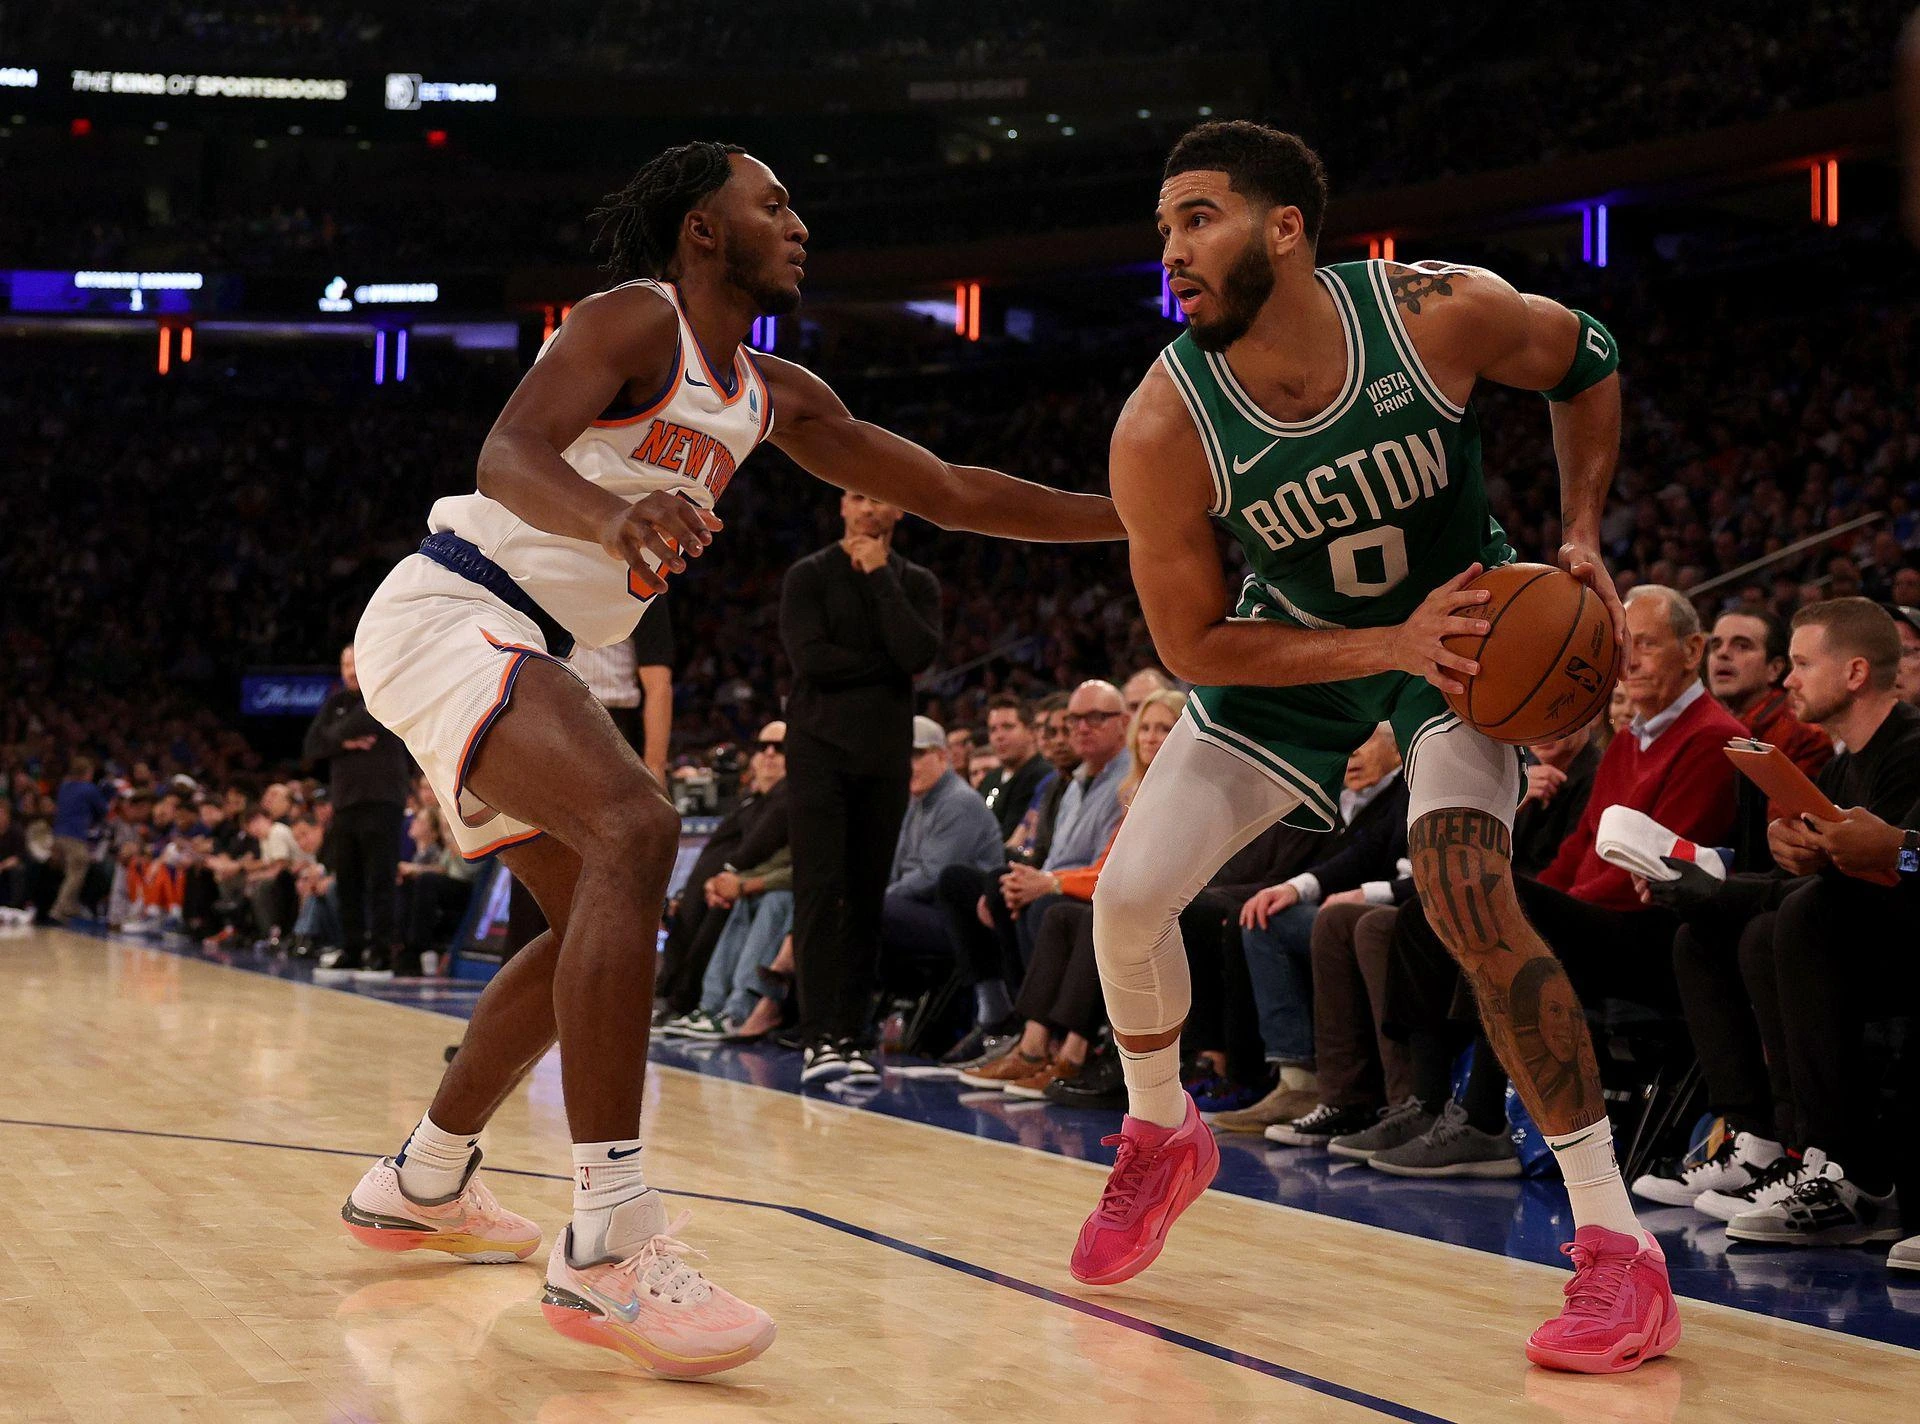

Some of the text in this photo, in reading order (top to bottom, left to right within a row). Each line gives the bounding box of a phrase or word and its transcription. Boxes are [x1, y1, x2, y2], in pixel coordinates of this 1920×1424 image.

[1365, 371, 1411, 403] VISTA
[1373, 387, 1415, 417] PRINT
[631, 417, 715, 482] NEW
[1240, 428, 1449, 552] BOSTON
[1327, 524, 1410, 599] 0
